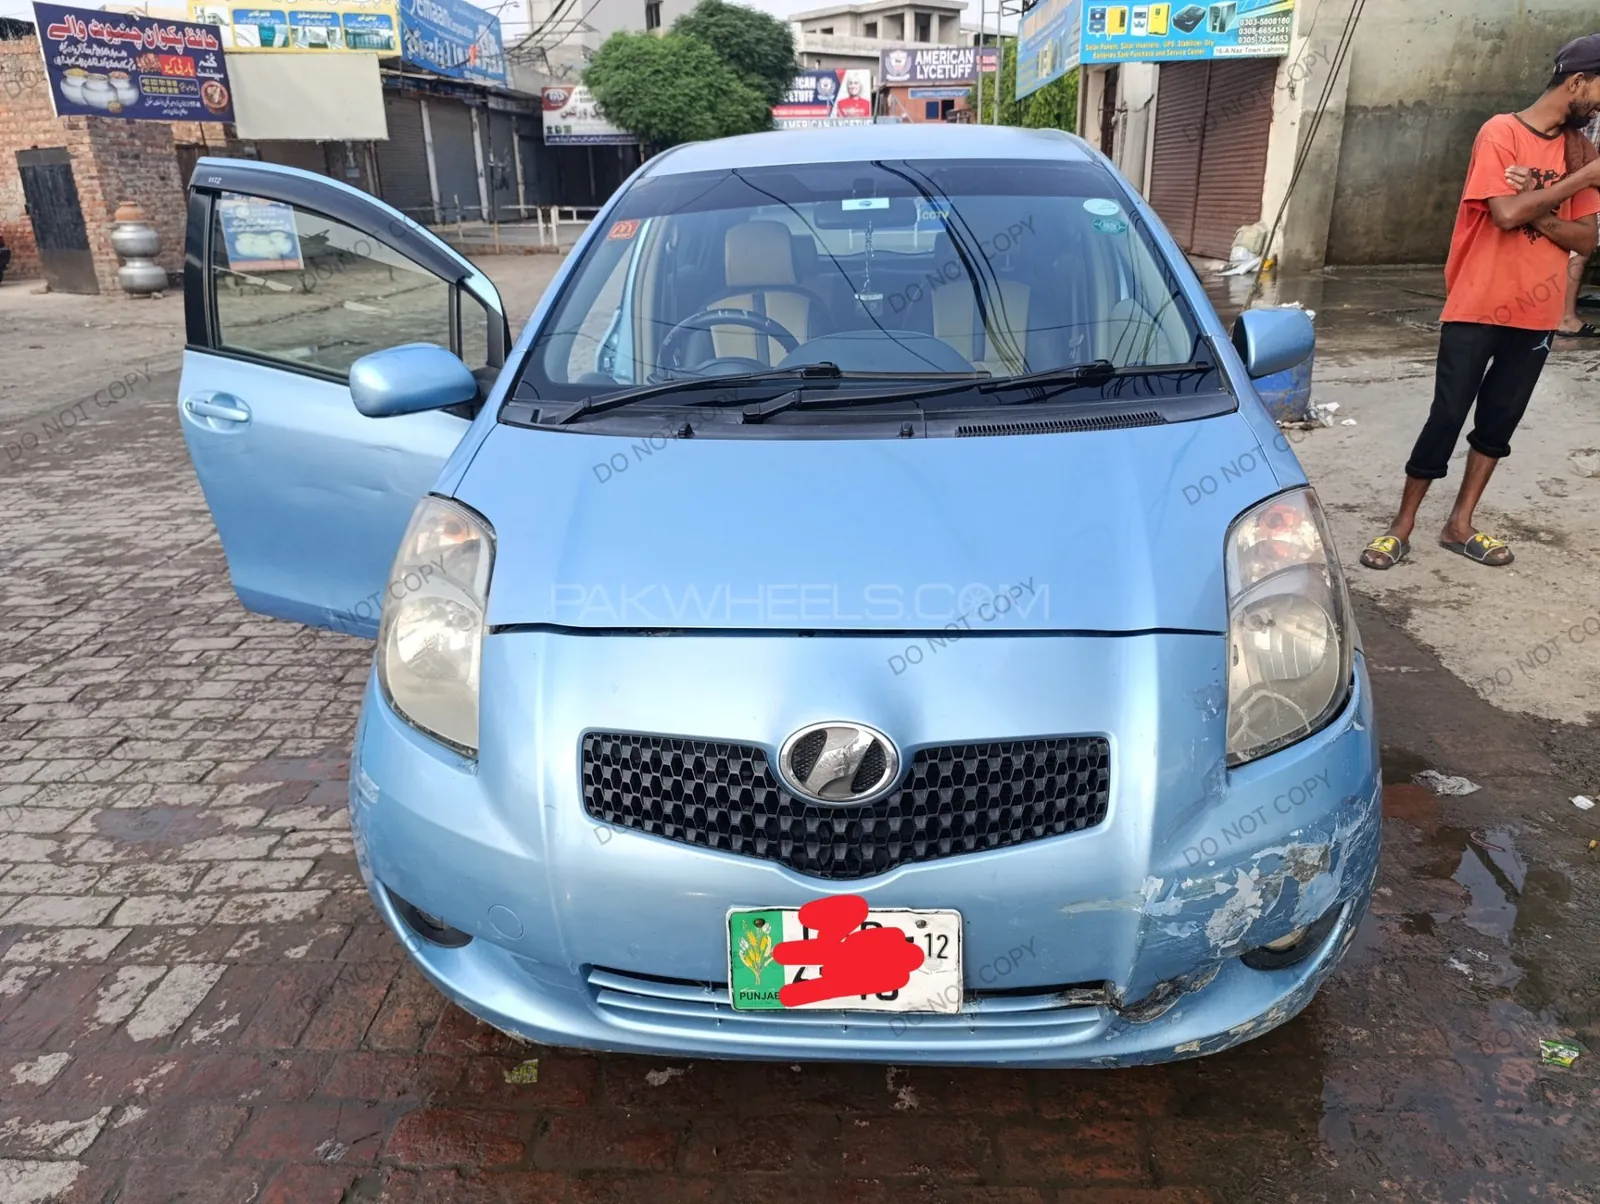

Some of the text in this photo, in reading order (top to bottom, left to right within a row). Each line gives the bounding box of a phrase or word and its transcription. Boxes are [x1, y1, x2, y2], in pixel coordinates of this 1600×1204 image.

[47, 15, 88, 41] والے
[915, 49, 975, 65] AMERICAN
[916, 64, 973, 79] LYCETUFF
[922, 211, 949, 220] CCTV
[924, 932, 949, 959] 12
